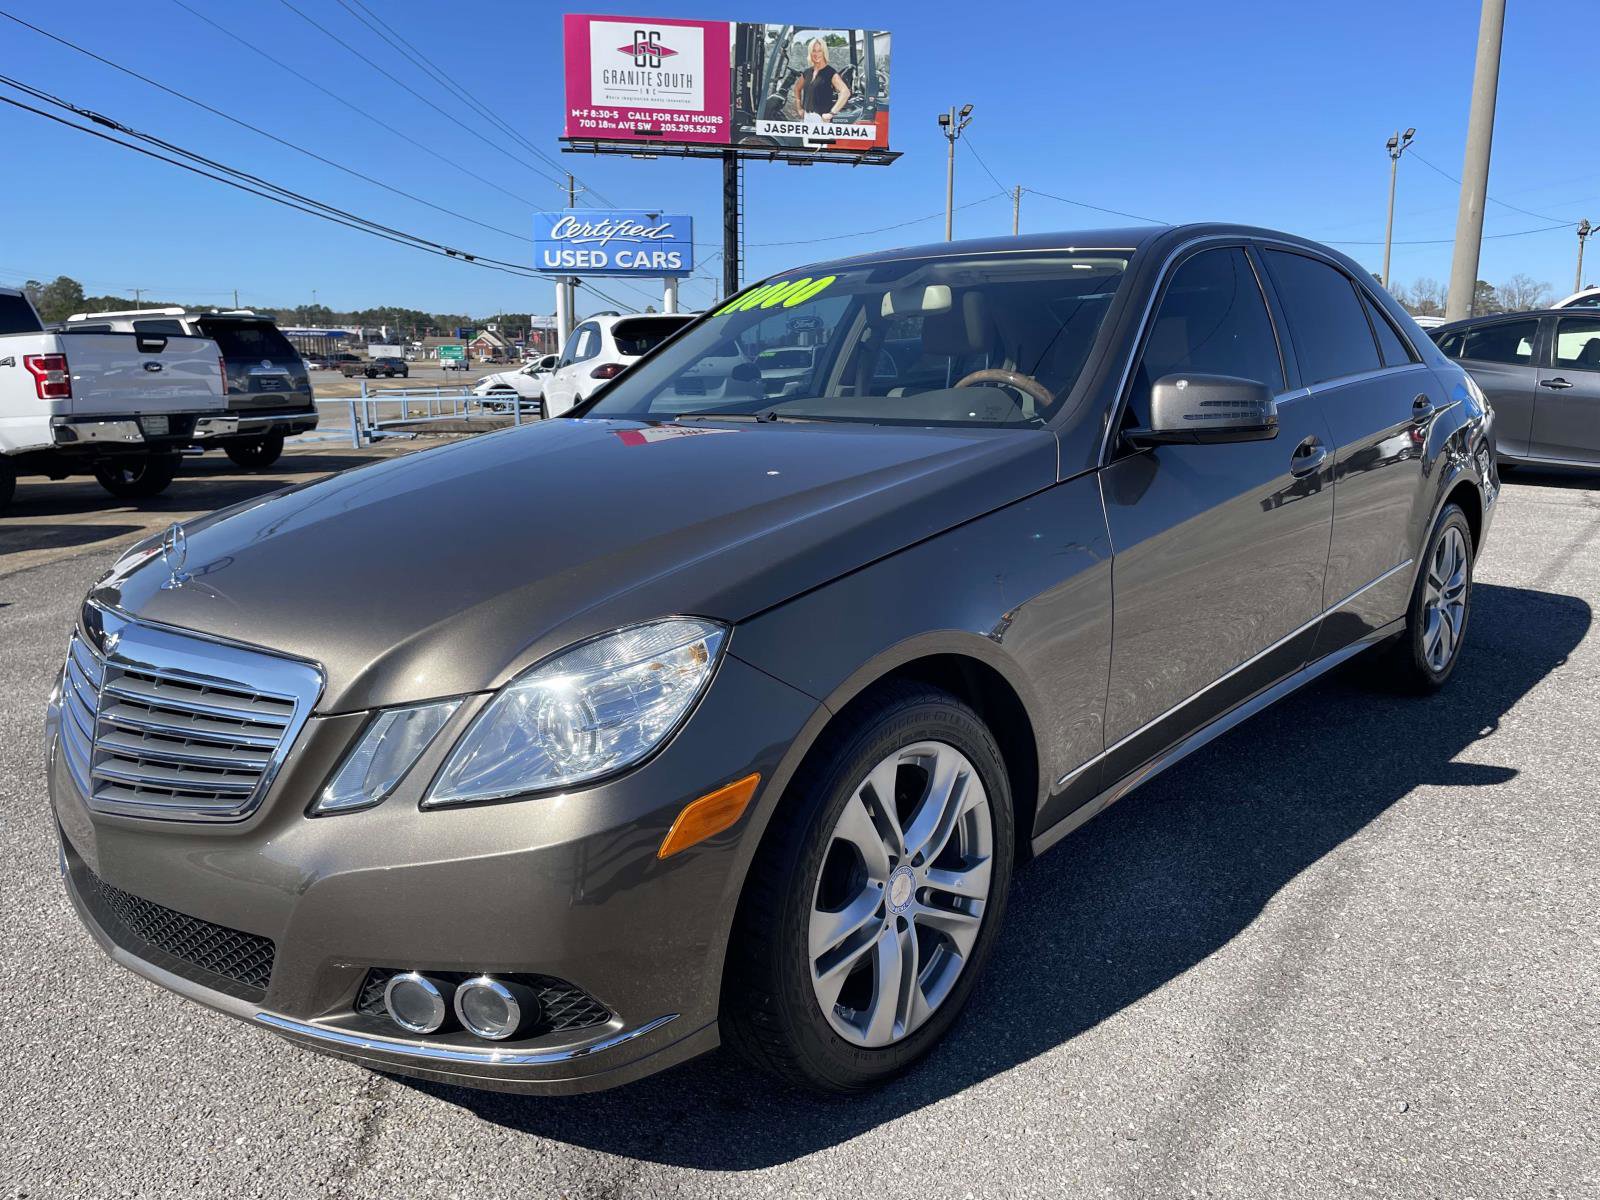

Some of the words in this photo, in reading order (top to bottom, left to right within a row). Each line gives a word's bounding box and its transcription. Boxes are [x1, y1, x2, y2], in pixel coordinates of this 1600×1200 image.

[633, 30, 661, 68] GS
[603, 69, 653, 87] GRANITE
[656, 72, 693, 89] SOUTH
[640, 88, 656, 96] INC
[571, 108, 589, 117] M-F
[590, 109, 619, 119] 8:30-5
[627, 111, 651, 121] CALL
[652, 113, 671, 122] FOR
[673, 114, 691, 122] SAT
[691, 115, 724, 124] HOURS
[579, 119, 597, 128] 700
[617, 121, 636, 130] AVE
[637, 121, 653, 131] SW
[660, 123, 718, 134] 205.295.5675
[764, 123, 809, 135] JASPER
[812, 125, 869, 138] ALABAMA
[550, 215, 675, 247] Certified
[544, 249, 609, 269] USED
[615, 250, 683, 270] CARS
